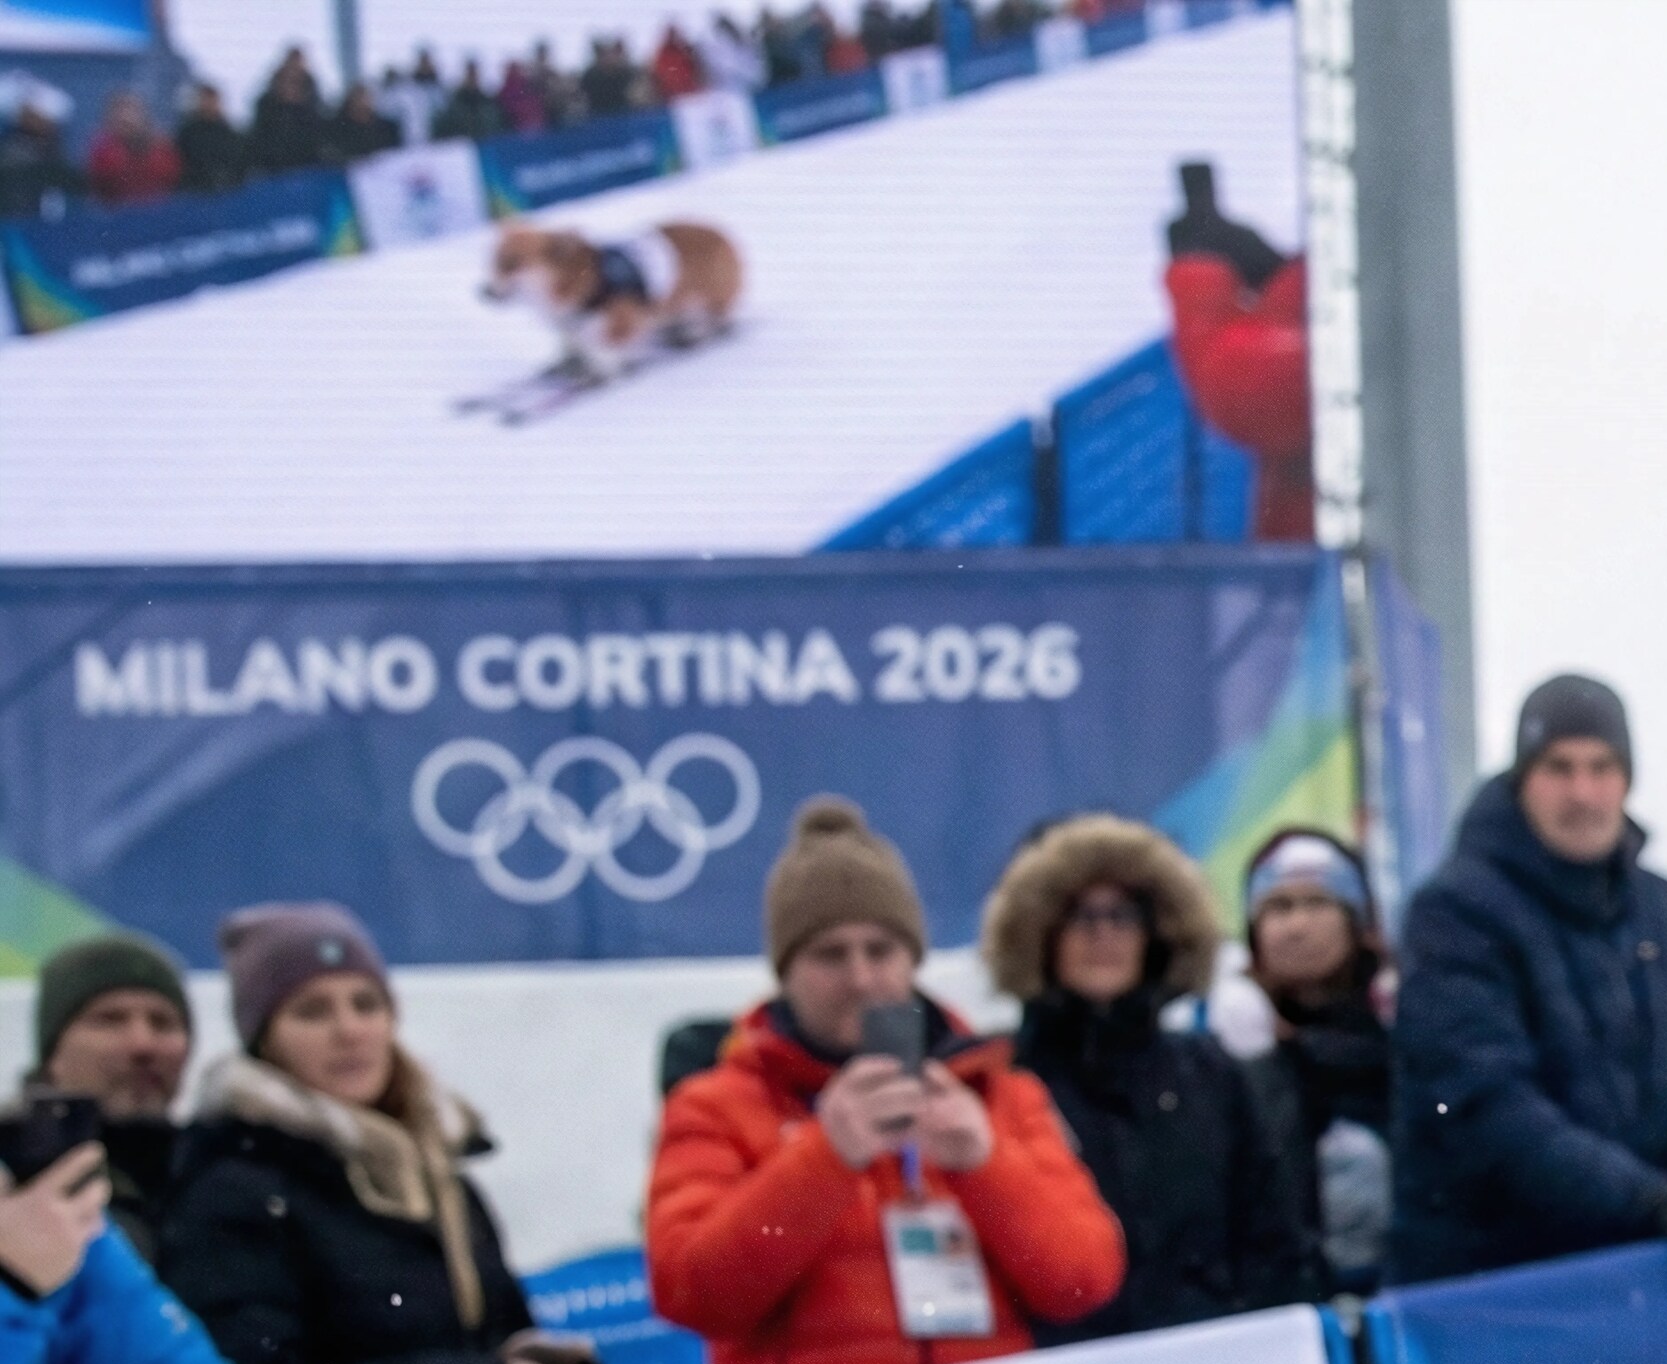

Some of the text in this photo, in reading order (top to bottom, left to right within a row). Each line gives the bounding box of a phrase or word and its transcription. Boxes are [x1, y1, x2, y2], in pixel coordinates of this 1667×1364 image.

[74, 621, 1083, 716] MILANO CORTINA 2026
